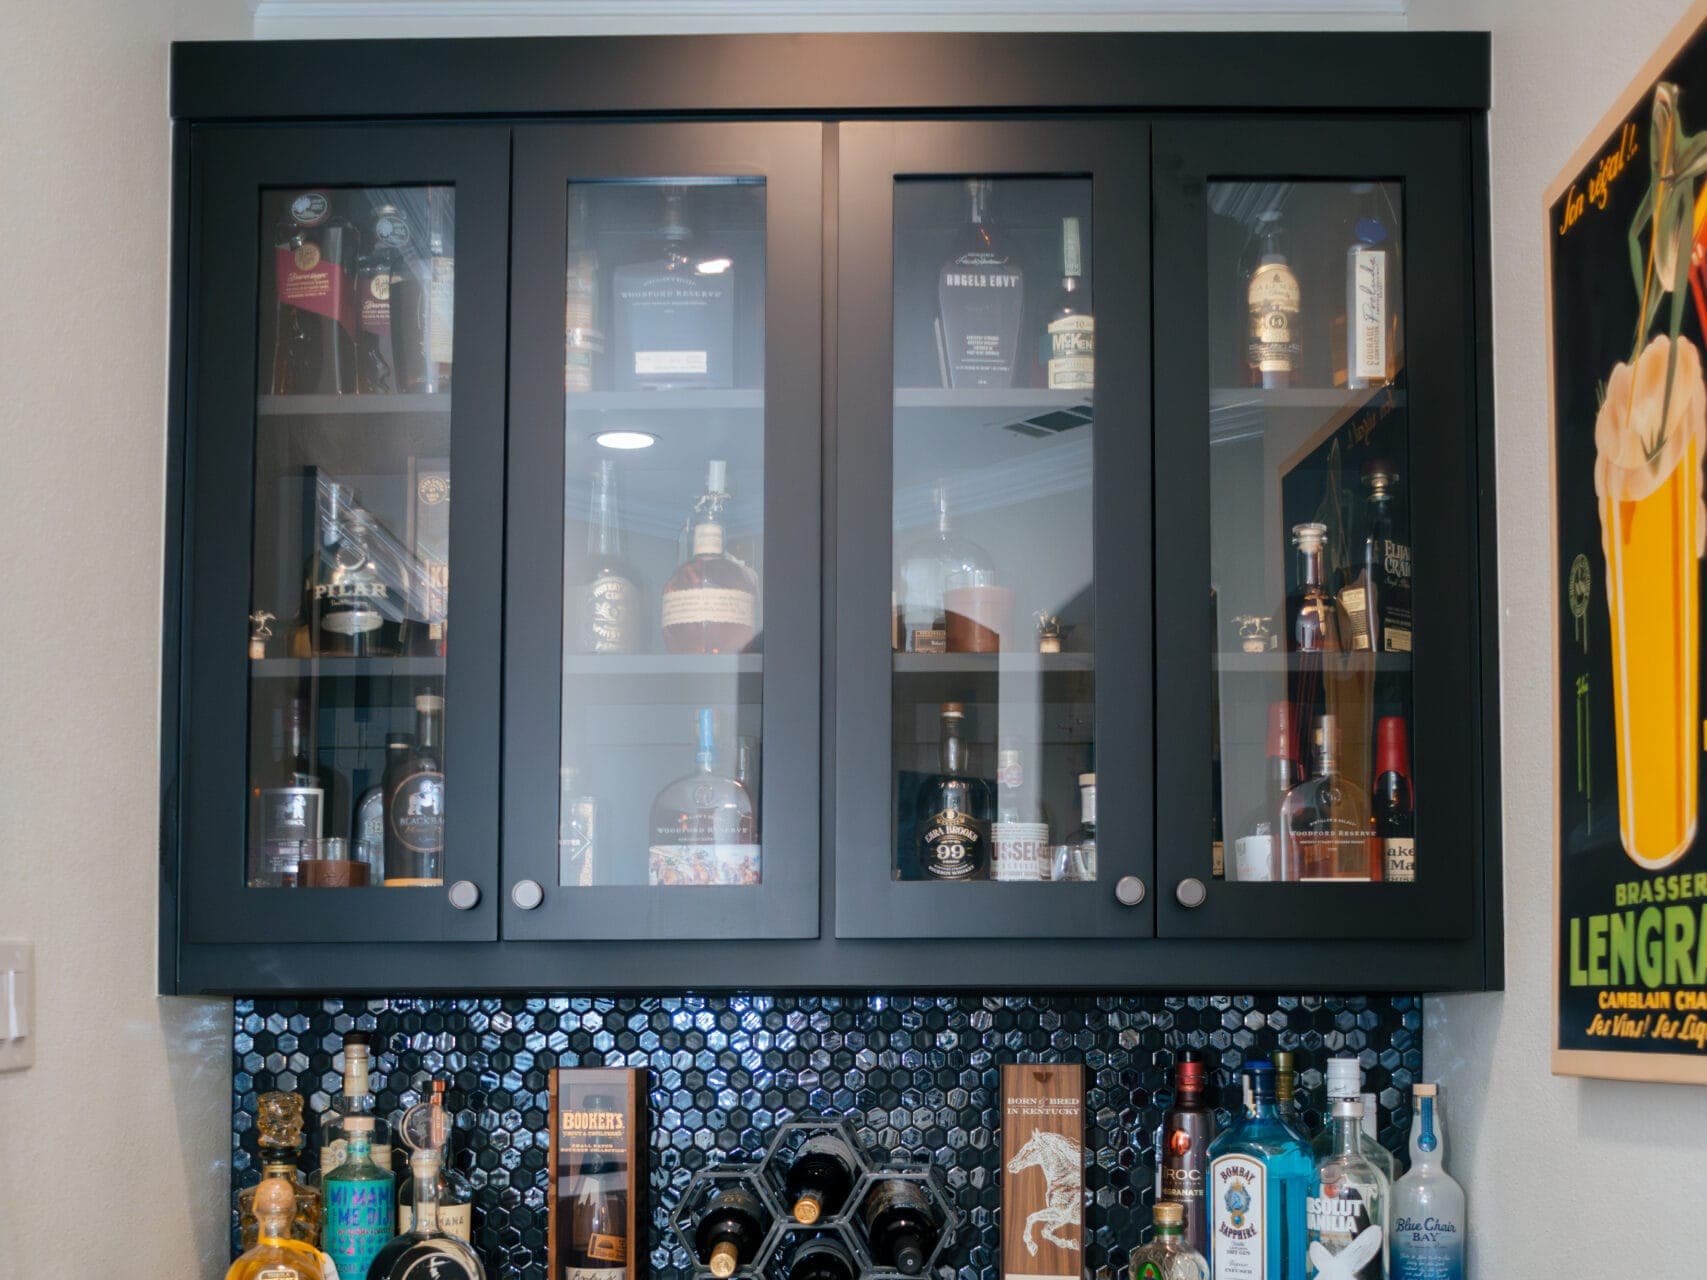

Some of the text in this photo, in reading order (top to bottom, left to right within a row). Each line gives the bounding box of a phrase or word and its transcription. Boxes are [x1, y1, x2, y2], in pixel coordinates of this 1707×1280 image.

[314, 582, 388, 600] PILAR
[936, 844, 966, 860] 99
[1598, 991, 1671, 1010] CAMBLAIN
[1007, 1097, 1038, 1105] BORN
[1049, 1097, 1080, 1105] BRED
[1219, 1165, 1256, 1184] BOMBAY
[1218, 1220, 1258, 1241] SAPPHIRE
[1395, 1216, 1456, 1233] Blue Chair
[1412, 1231, 1438, 1242] BAY
